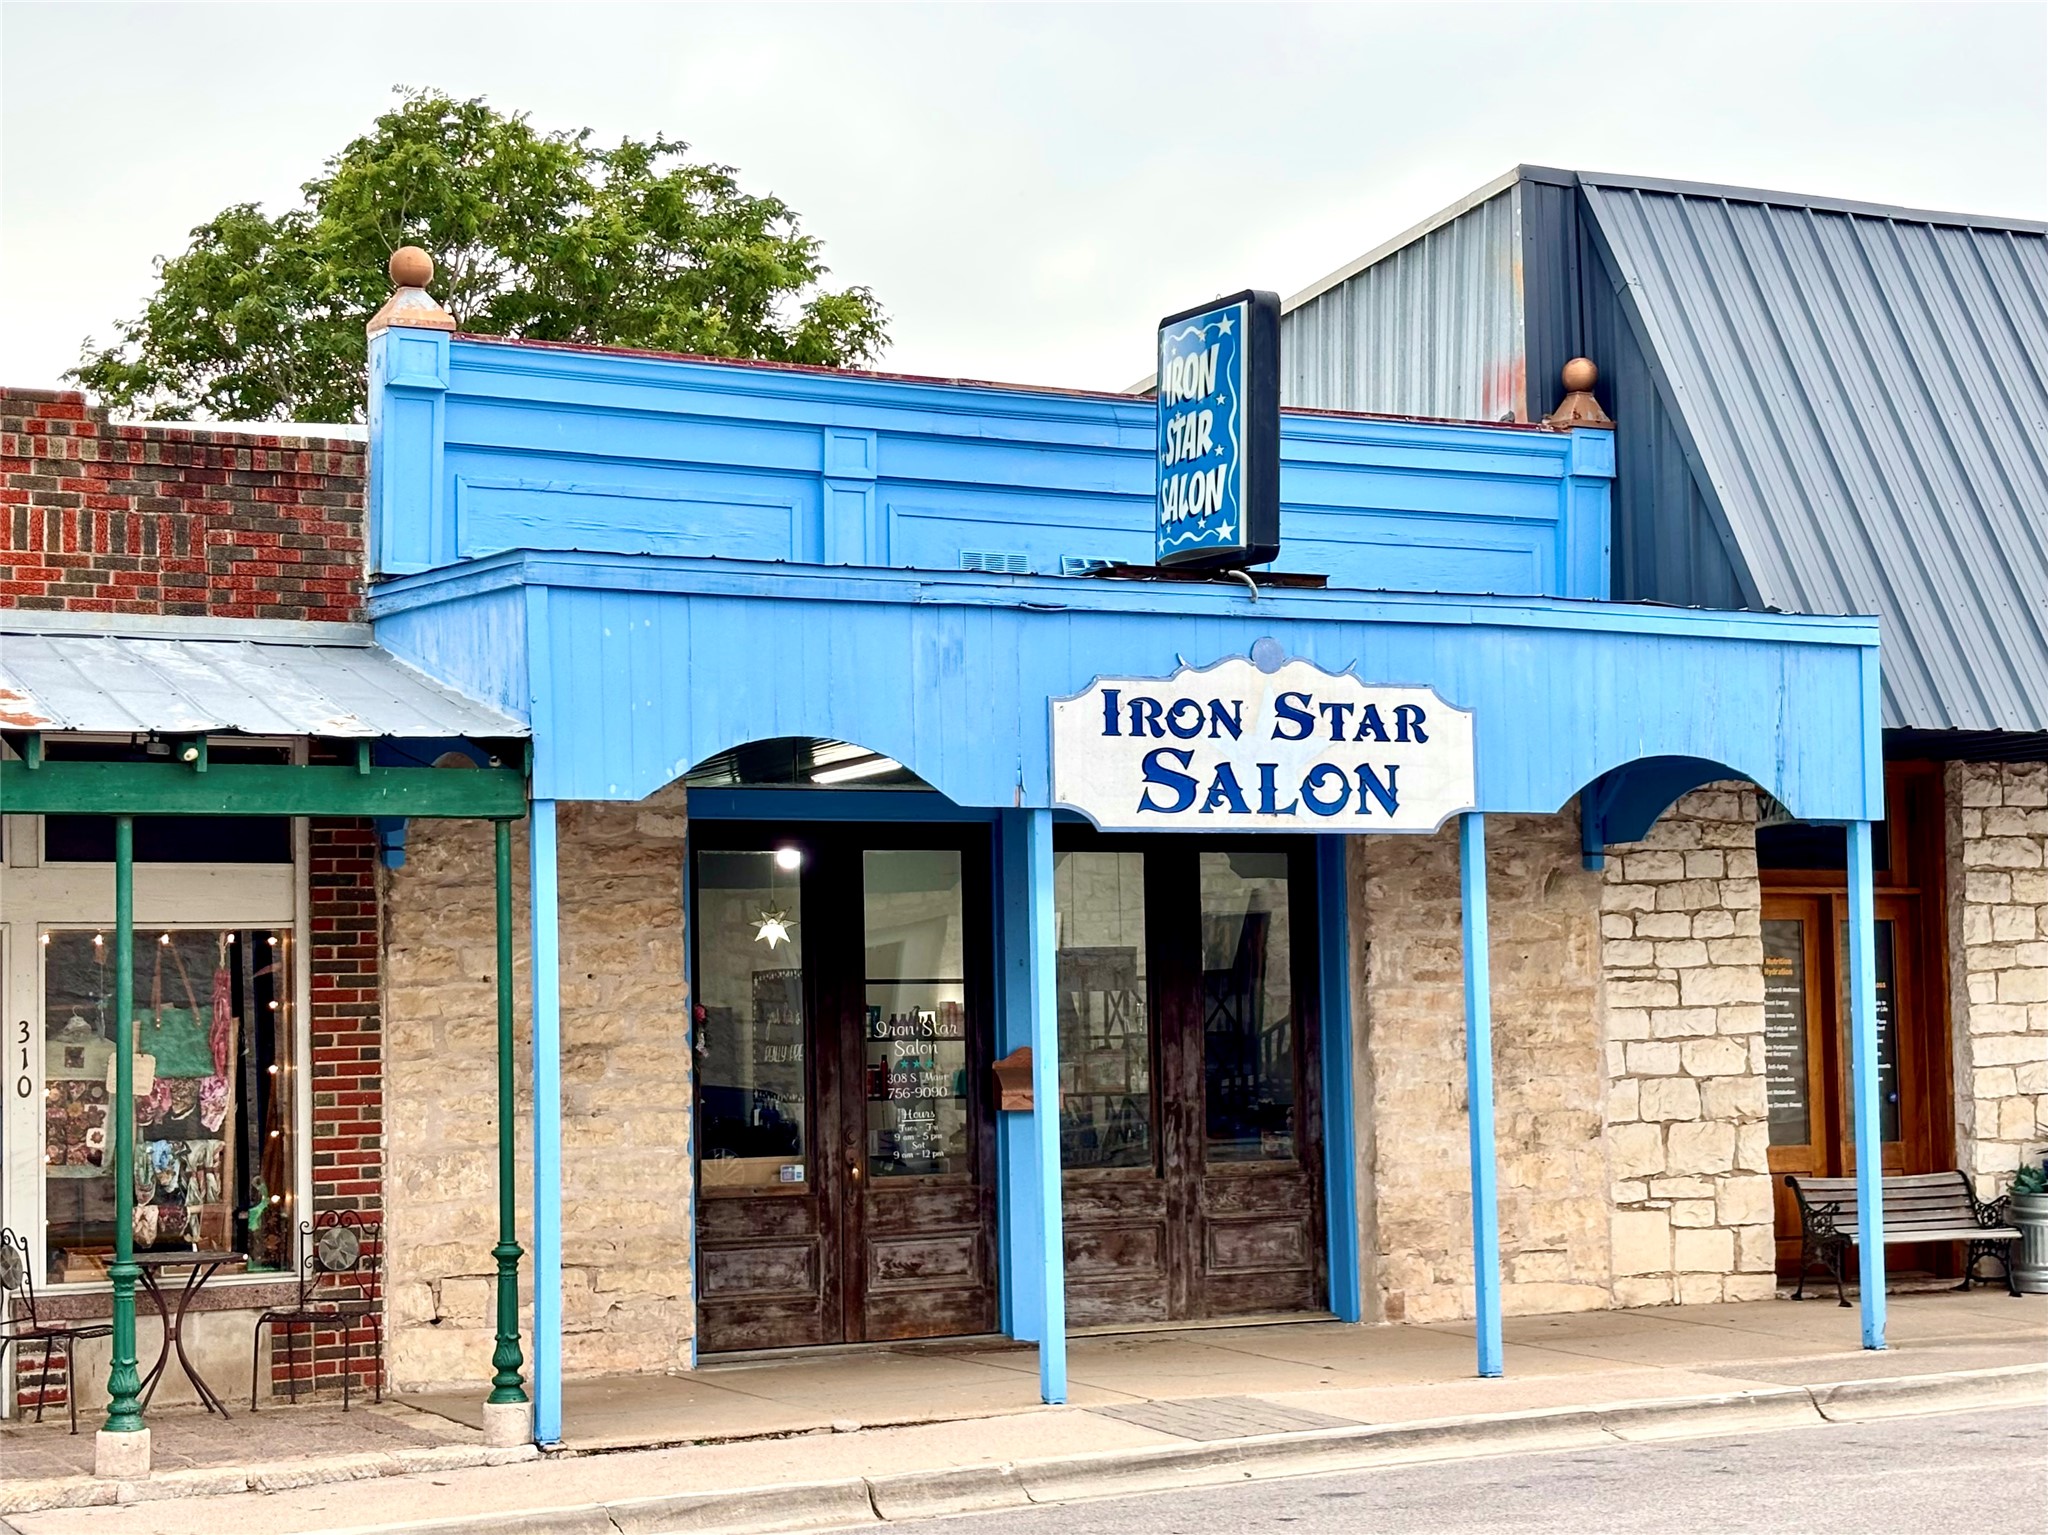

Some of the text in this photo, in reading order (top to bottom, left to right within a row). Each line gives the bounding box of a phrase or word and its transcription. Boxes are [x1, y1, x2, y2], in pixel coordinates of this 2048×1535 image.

[1165, 343, 1220, 408] IRON
[1165, 409, 1213, 467] STAR
[1161, 463, 1227, 525] SALON
[1101, 689, 1429, 744] IRON STAR
[1137, 747, 1400, 818] SALON
[873, 1018, 958, 1038] Iron Star
[894, 1039, 938, 1057] Salon
[17, 1020, 32, 1098] 310
[887, 1072, 907, 1084] 308
[887, 1087, 948, 1100] 756-9090
[902, 1109, 935, 1120] Hours
[894, 1133, 901, 1142] 9
[923, 1132, 929, 1140] 5
[931, 1133, 943, 1141] pm
[912, 1142, 925, 1150] Sat
[893, 1151, 900, 1159] 9
[922, 1149, 930, 1158] 12
[932, 1151, 944, 1159] pm
